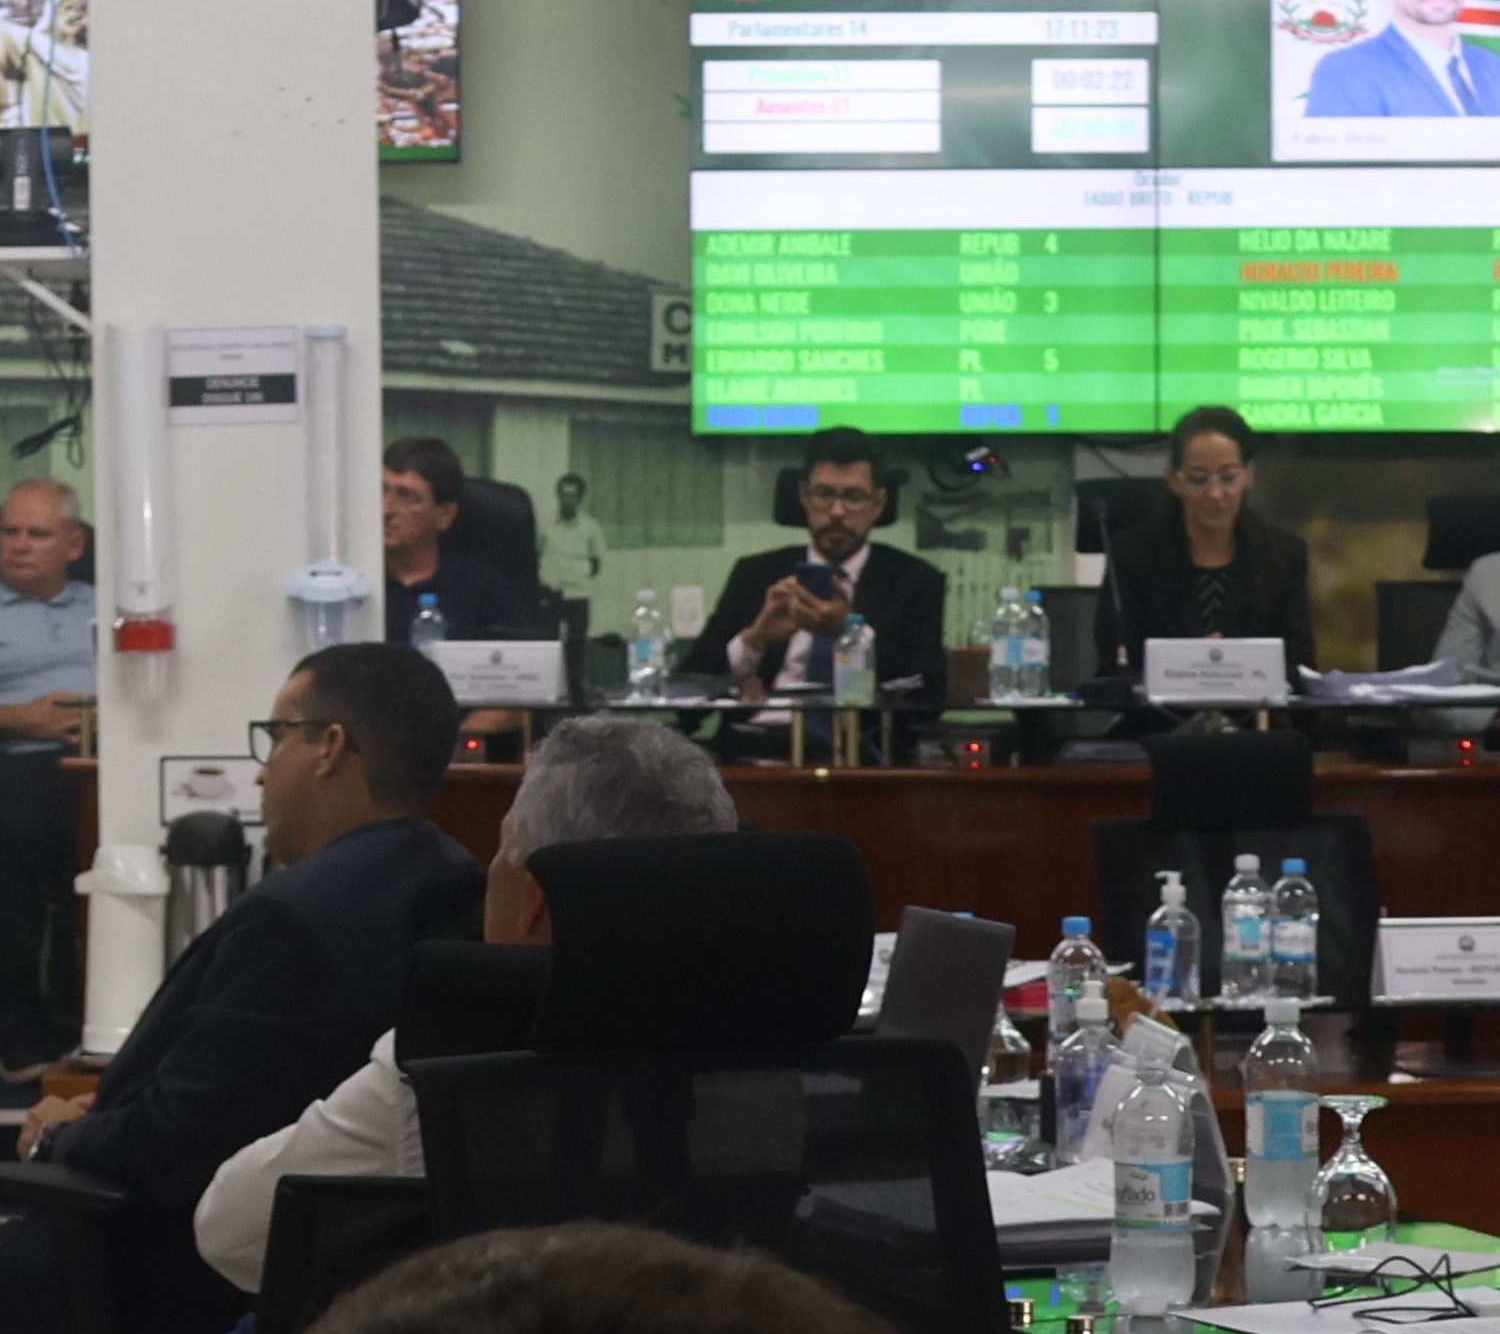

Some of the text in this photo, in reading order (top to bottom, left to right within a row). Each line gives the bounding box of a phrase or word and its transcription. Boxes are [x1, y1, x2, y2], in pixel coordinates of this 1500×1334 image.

[727, 19, 869, 38] Parlamentares 14
[1044, 19, 1119, 39] 17:11:23
[959, 233, 1020, 255] REPUB
[1043, 233, 1058, 255] 4
[1043, 291, 1058, 313] 3
[959, 349, 983, 371] PL
[1043, 349, 1058, 371] 5
[959, 378, 983, 401] PL
[1045, 405, 1058, 427] 1
